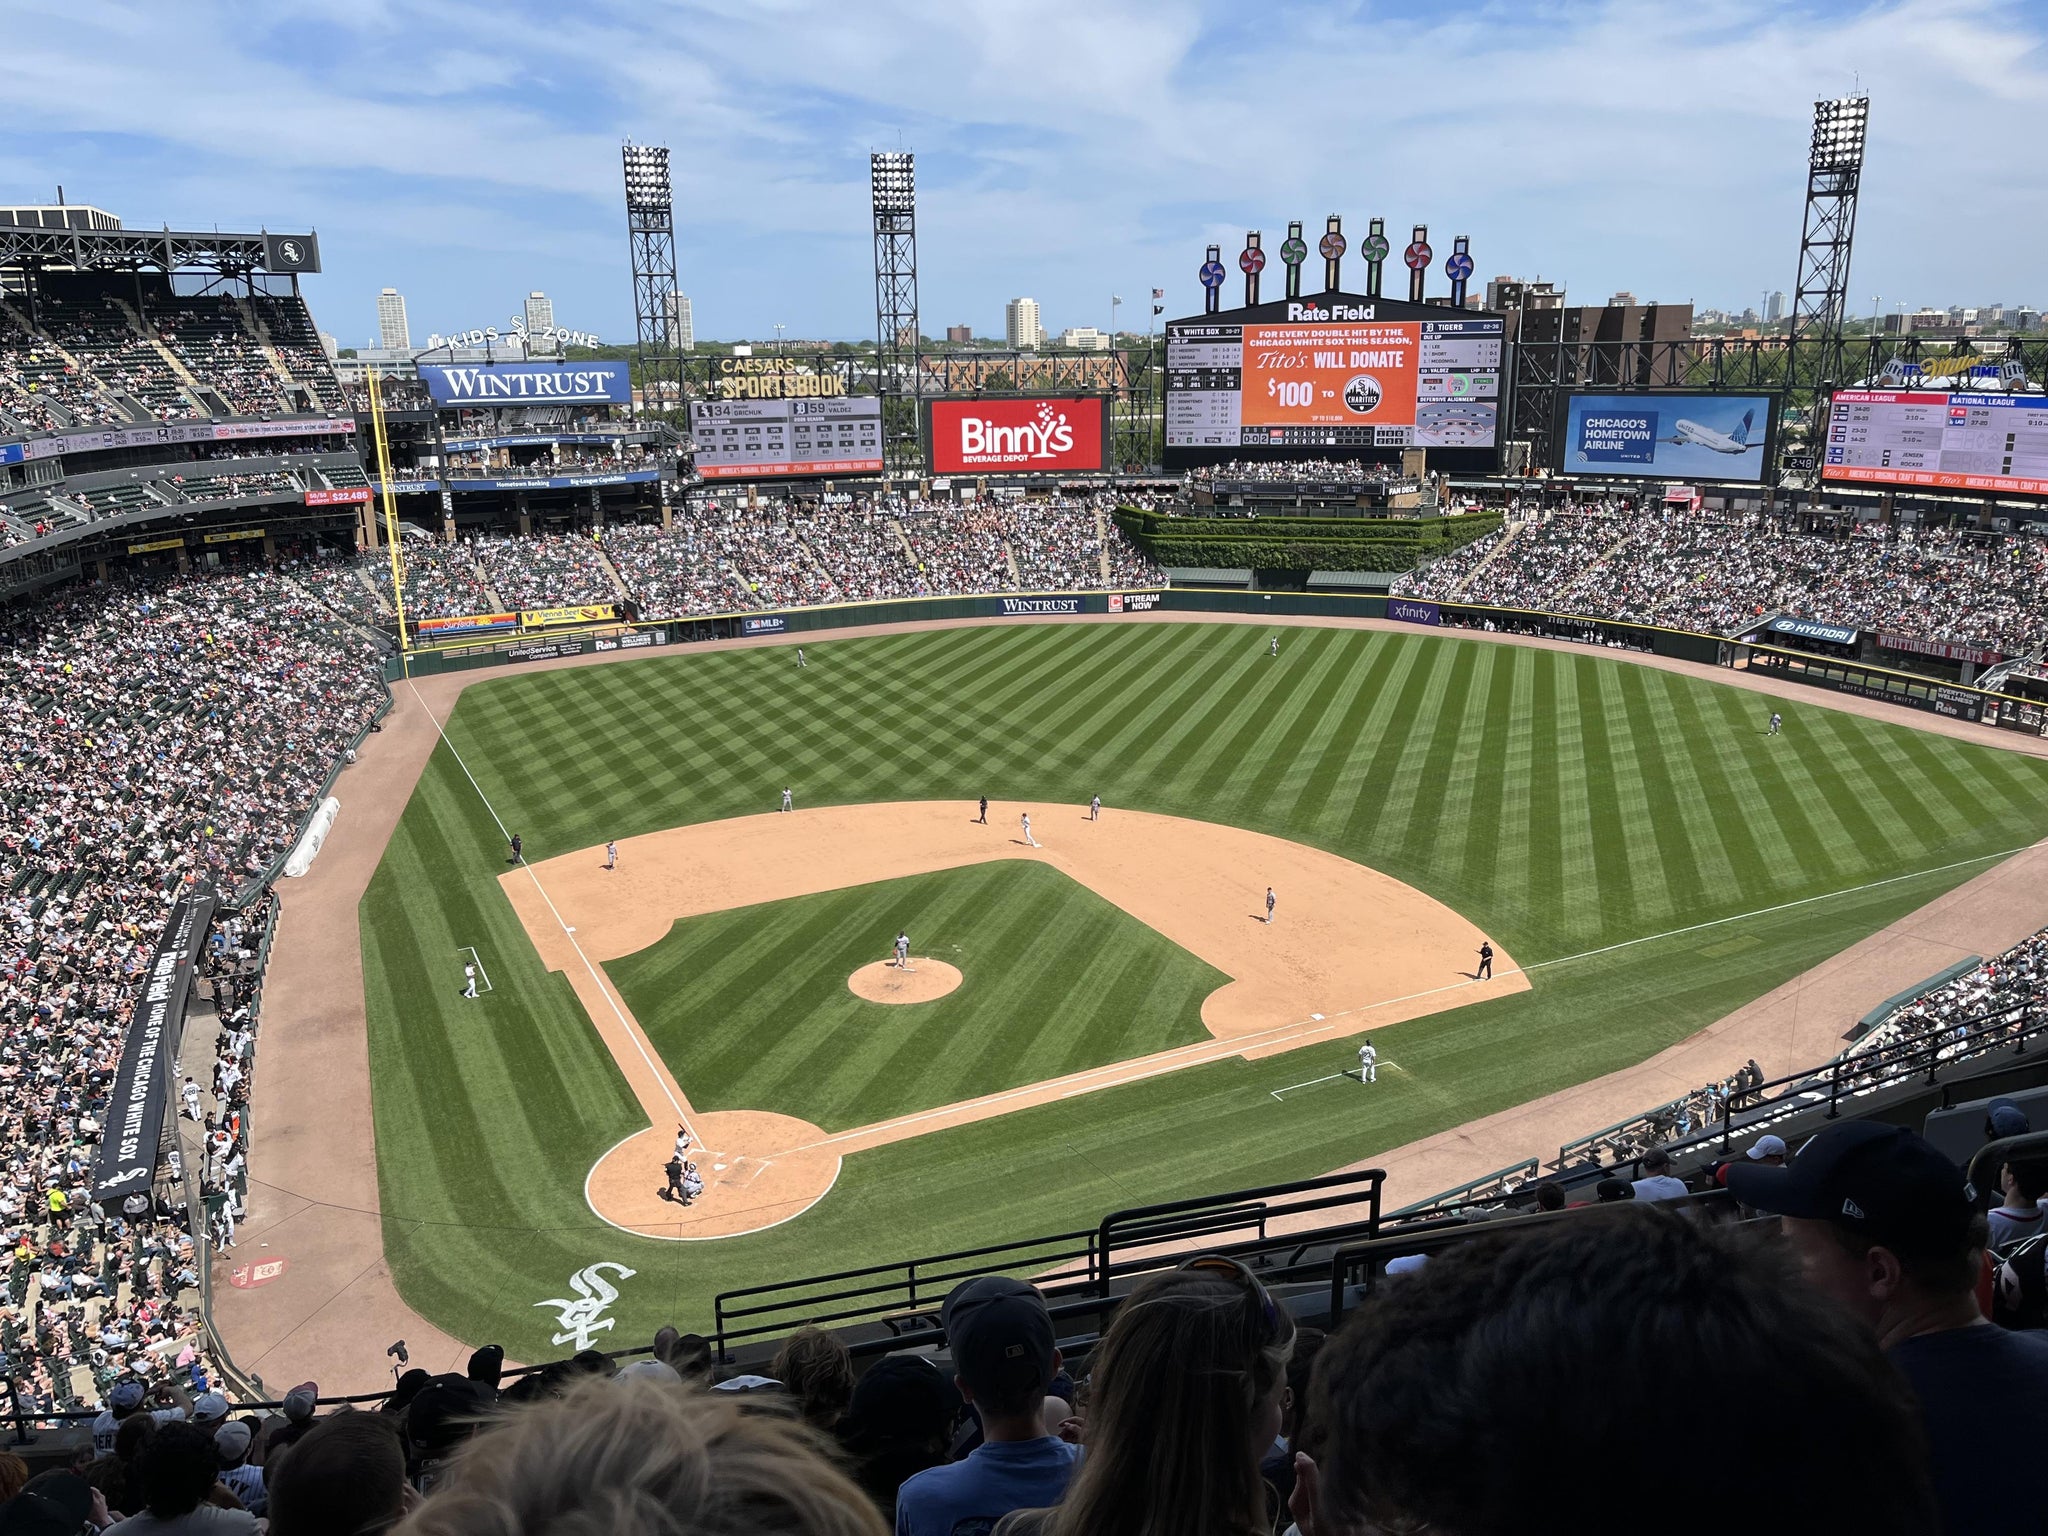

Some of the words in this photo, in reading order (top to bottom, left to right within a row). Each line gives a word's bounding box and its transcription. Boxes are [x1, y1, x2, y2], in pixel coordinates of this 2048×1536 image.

[1288, 303, 1329, 322] Rate
[1332, 303, 1375, 320] Field
[542, 326, 600, 350] ZONE
[1183, 328, 1205, 336] WHITE
[1279, 330, 1310, 338] EVERY
[1384, 328, 1404, 336] THE
[446, 326, 499, 351] KIDS
[1249, 339, 1292, 347] CHICAGO
[1293, 338, 1323, 346] WHITE
[1325, 338, 1344, 346] SOX
[1371, 337, 1413, 346] SEASON,
[721, 358, 795, 373] CAESARS
[1256, 350, 1308, 369] Tito's
[1314, 351, 1346, 369] WILL
[1350, 350, 1404, 368] DONATE
[1920, 354, 1983, 382] Miller
[1970, 365, 2000, 378] TIME
[2003, 360, 2024, 380] Lite
[442, 369, 610, 397] WINTRUST
[722, 374, 846, 398] SPORTSBOOK
[1321, 390, 1335, 398] TO
[1347, 396, 1377, 404] CHARITIES
[1835, 394, 1870, 402] AMERICAN
[1871, 395, 1897, 403] LEAGUE
[1951, 397, 1987, 405] NATIONAL
[1988, 398, 2016, 406] LEAGUE
[714, 405, 731, 417] 34
[810, 404, 825, 413] 59
[1586, 418, 1647, 429] CHICAGO'S
[1678, 422, 1694, 433] UNITED
[1585, 429, 1650, 440] HOMETOWN
[1584, 440, 1624, 450] AIRLINE
[963, 454, 1002, 463] BEVERAGE
[1003, 453, 1028, 462] DEPOT
[1849, 470, 1874, 479] AMERICA'S
[1874, 471, 1897, 480] ORIGINAL
[1898, 473, 1914, 481] CRAFT
[496, 480, 527, 488] Hometown
[527, 480, 550, 488] Banking
[1939, 476, 1961, 484] Tito's
[1965, 477, 1994, 486] AMERICA'S
[1994, 479, 2019, 489] ORIGINAL
[2020, 481, 2038, 490] CRAFT
[1389, 487, 1401, 496] FAN
[1401, 485, 1418, 494] DECK
[823, 492, 852, 504] Modelo
[1124, 594, 1160, 603] STREAM
[1003, 599, 1078, 613] WINTRUST
[1131, 602, 1153, 610] NOW
[537, 609, 562, 618] Vienna
[563, 608, 580, 617] Beef
[1395, 605, 1431, 622] xfinity
[442, 619, 475, 630] Surfside
[760, 618, 784, 628] MLB+
[1795, 624, 1849, 640] HYUNDAI
[508, 645, 557, 657] UnitedService
[595, 640, 617, 650] Rate
[1880, 635, 1949, 658] WHITTINGHAM
[1950, 647, 1983, 663] MEATS
[528, 652, 559, 660] Companies
[1937, 693, 1974, 705] WELLNESS
[1938, 687, 1980, 701] EVERYTHING
[1935, 701, 1958, 715] Rate
[147, 1002, 167, 1027] HOME
[144, 1026, 161, 1039] OF
[139, 1039, 158, 1059] THE
[129, 1058, 154, 1102] CHICAGO
[123, 1101, 146, 1137] WHITE
[118, 1137, 138, 1162] SOX
